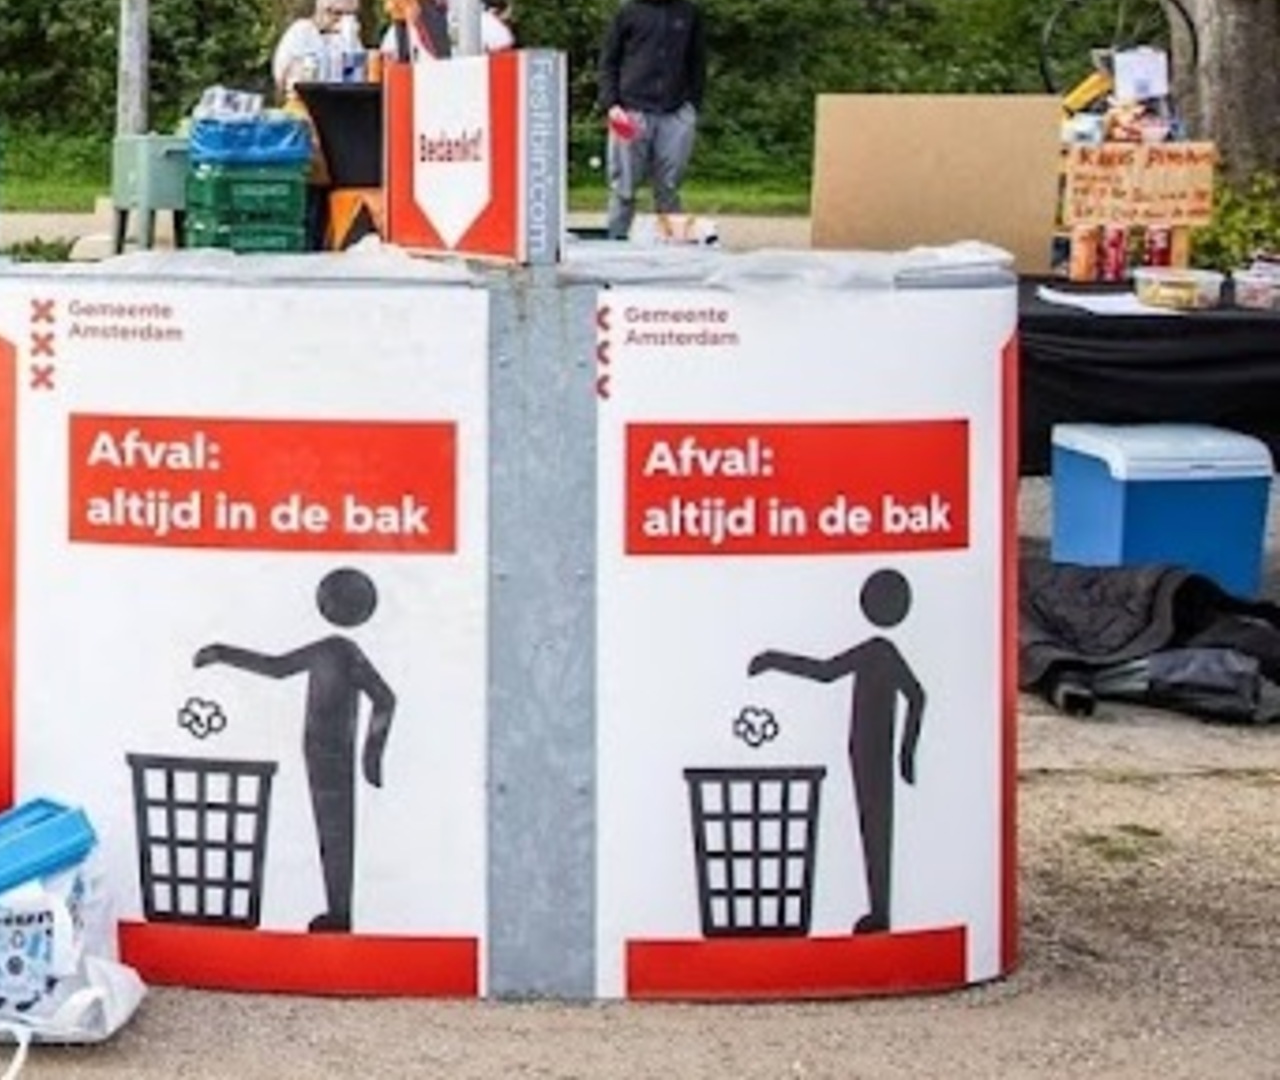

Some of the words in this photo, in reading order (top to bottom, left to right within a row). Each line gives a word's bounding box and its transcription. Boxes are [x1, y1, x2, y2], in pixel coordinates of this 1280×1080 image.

[68, 299, 173, 320] Gemeente
[623, 306, 728, 324] Gemeente
[68, 321, 184, 342] Amsterdam
[623, 328, 739, 347] Amsterdam
[86, 430, 221, 471] Afval:
[643, 437, 774, 478] Afval:
[86, 488, 201, 537] altijd
[215, 492, 256, 531] in
[270, 493, 329, 533] de
[343, 494, 429, 536] bak
[642, 497, 755, 545] altijd
[768, 498, 807, 536] in
[818, 495, 873, 535] de
[882, 494, 951, 534] bak
